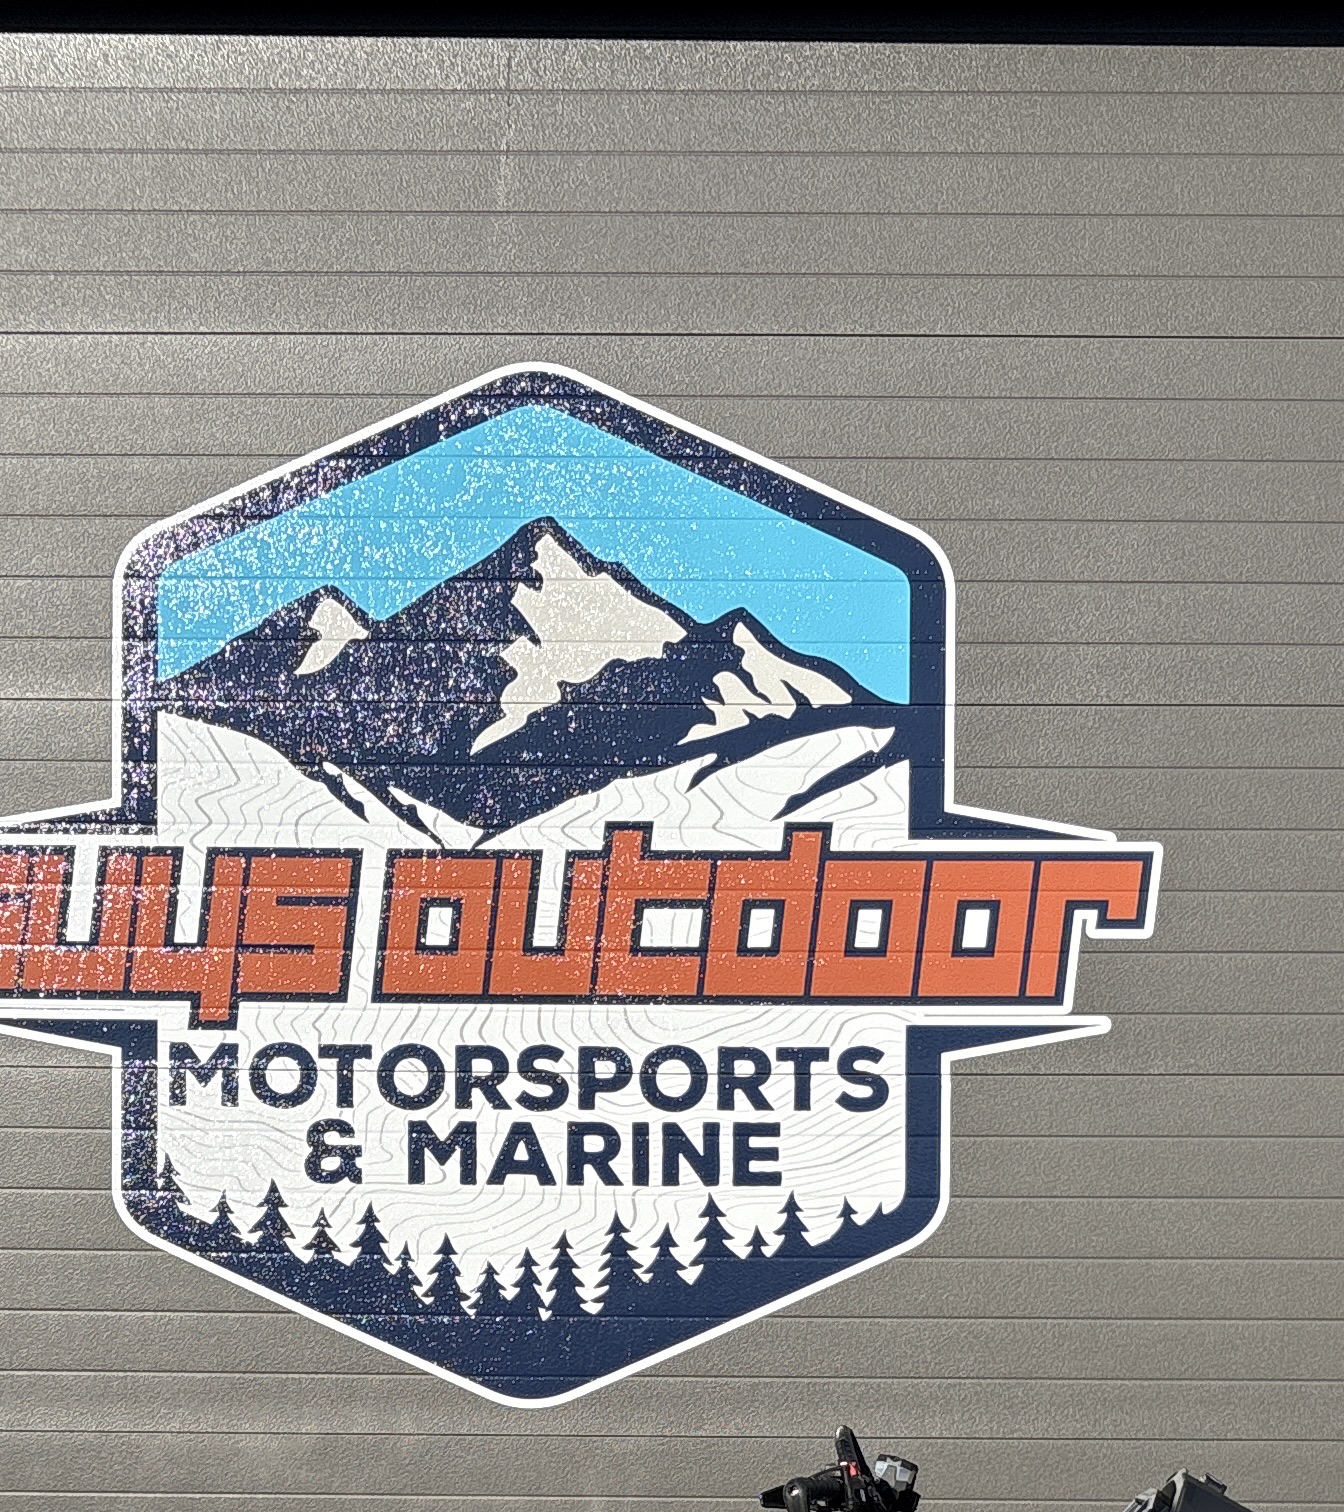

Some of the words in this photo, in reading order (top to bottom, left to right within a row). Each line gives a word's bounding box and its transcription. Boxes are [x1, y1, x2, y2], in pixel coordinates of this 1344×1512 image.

[168, 1041, 890, 1113] MOTORSPORTS
[304, 1118, 364, 1186] &
[407, 1120, 783, 1187] MARINE
